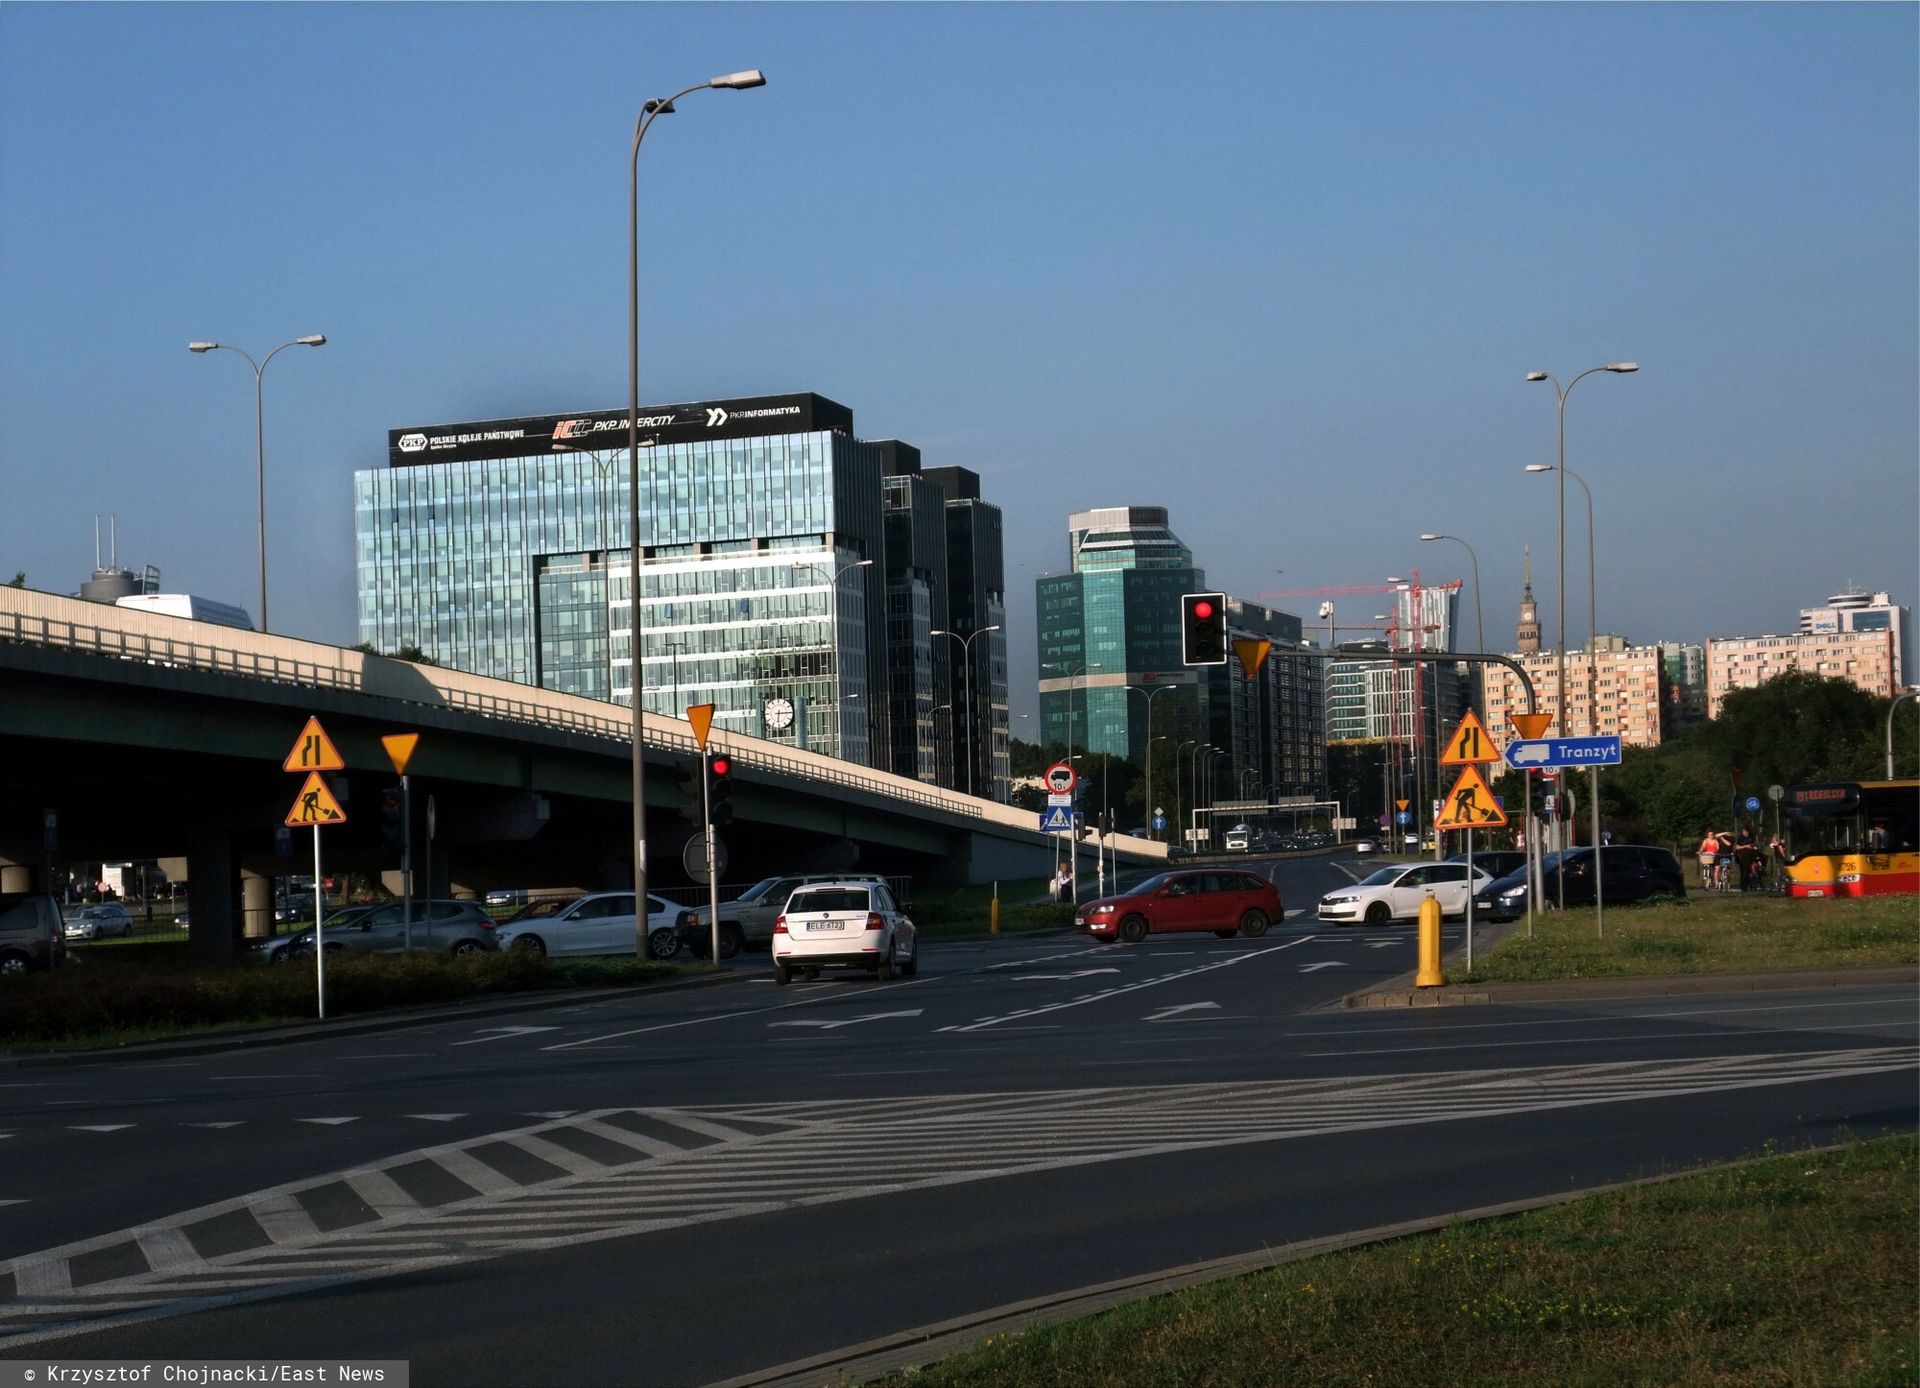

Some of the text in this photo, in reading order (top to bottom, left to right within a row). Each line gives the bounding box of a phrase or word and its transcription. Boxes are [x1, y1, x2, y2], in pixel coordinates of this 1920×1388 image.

[593, 415, 675, 432] PKP INERCITY
[430, 429, 524, 445] POLSKIE KOLEJE PAŃSTWOWE
[1559, 744, 1616, 760] Tranzyt
